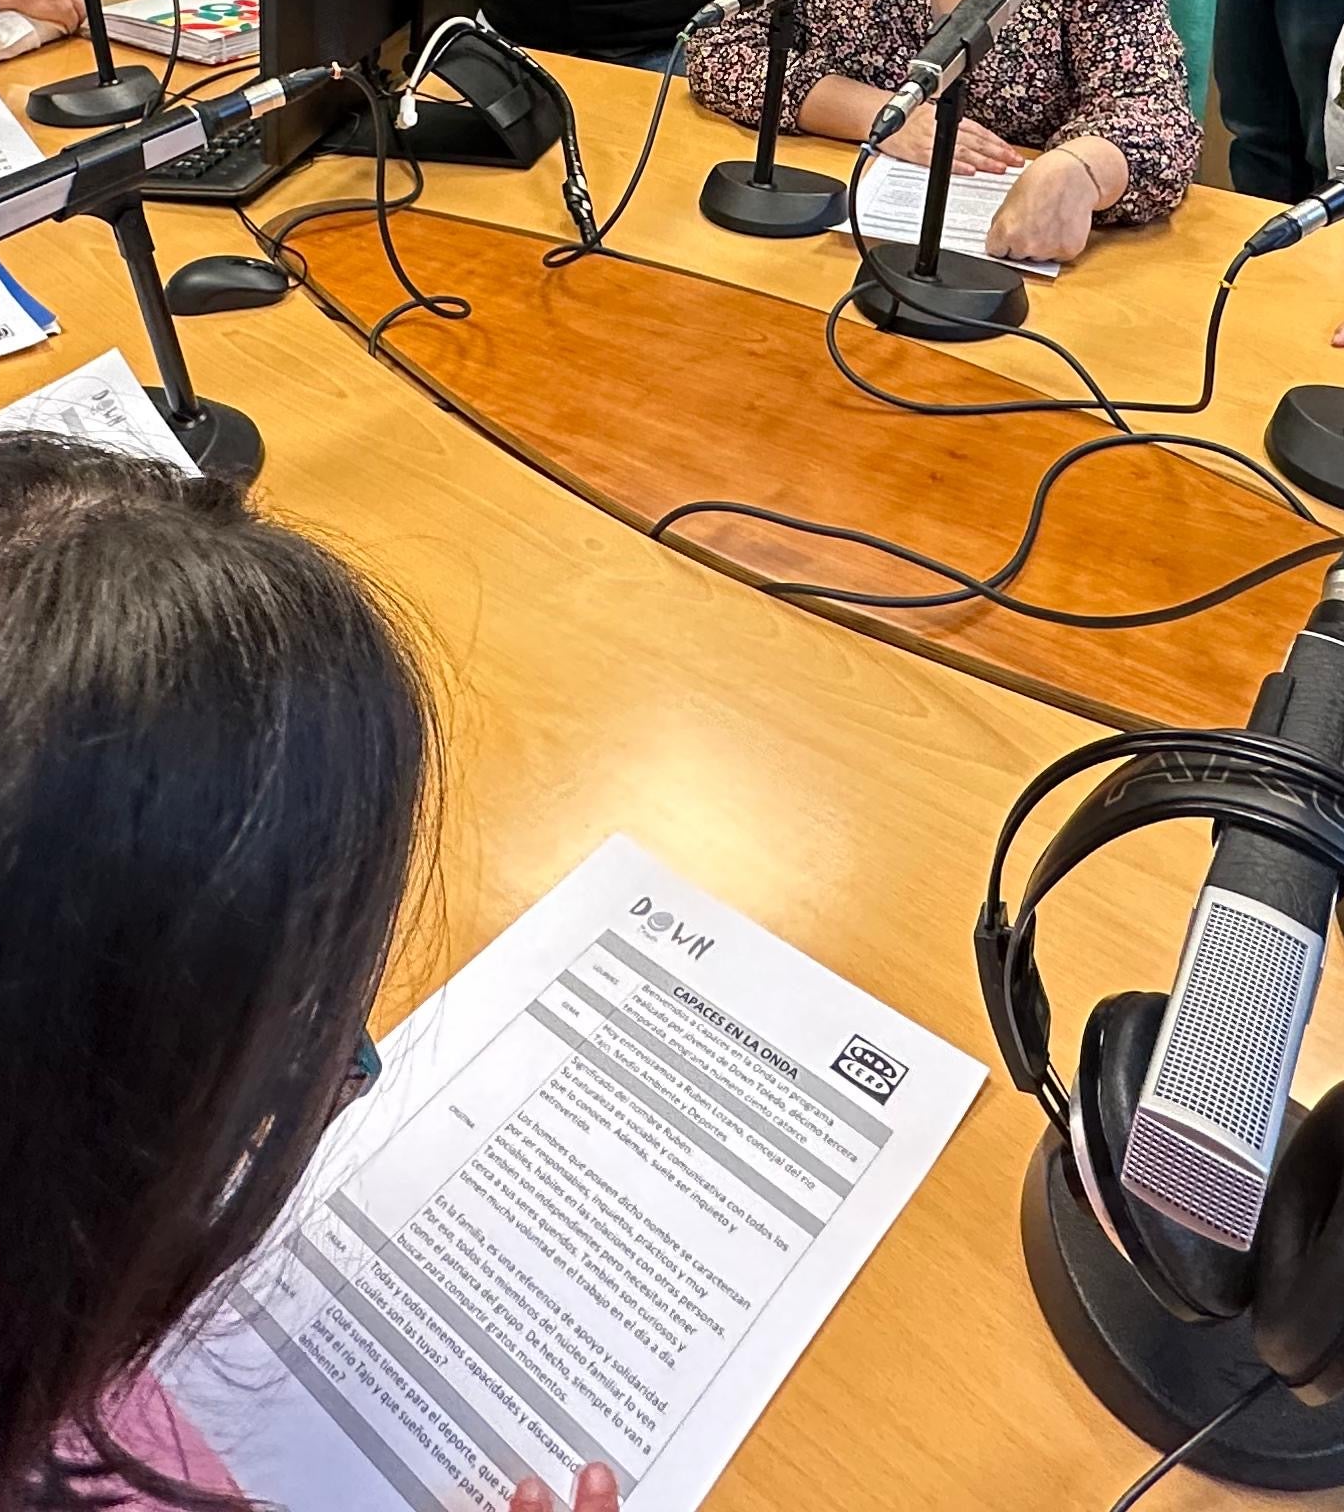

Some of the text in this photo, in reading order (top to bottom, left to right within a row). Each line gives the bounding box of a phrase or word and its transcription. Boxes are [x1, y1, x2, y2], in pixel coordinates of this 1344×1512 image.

[671, 985, 800, 1080] CAPACES EN LA ONDA
[846, 1063, 884, 1089] CERO
[853, 1047, 894, 1077] ONDA
